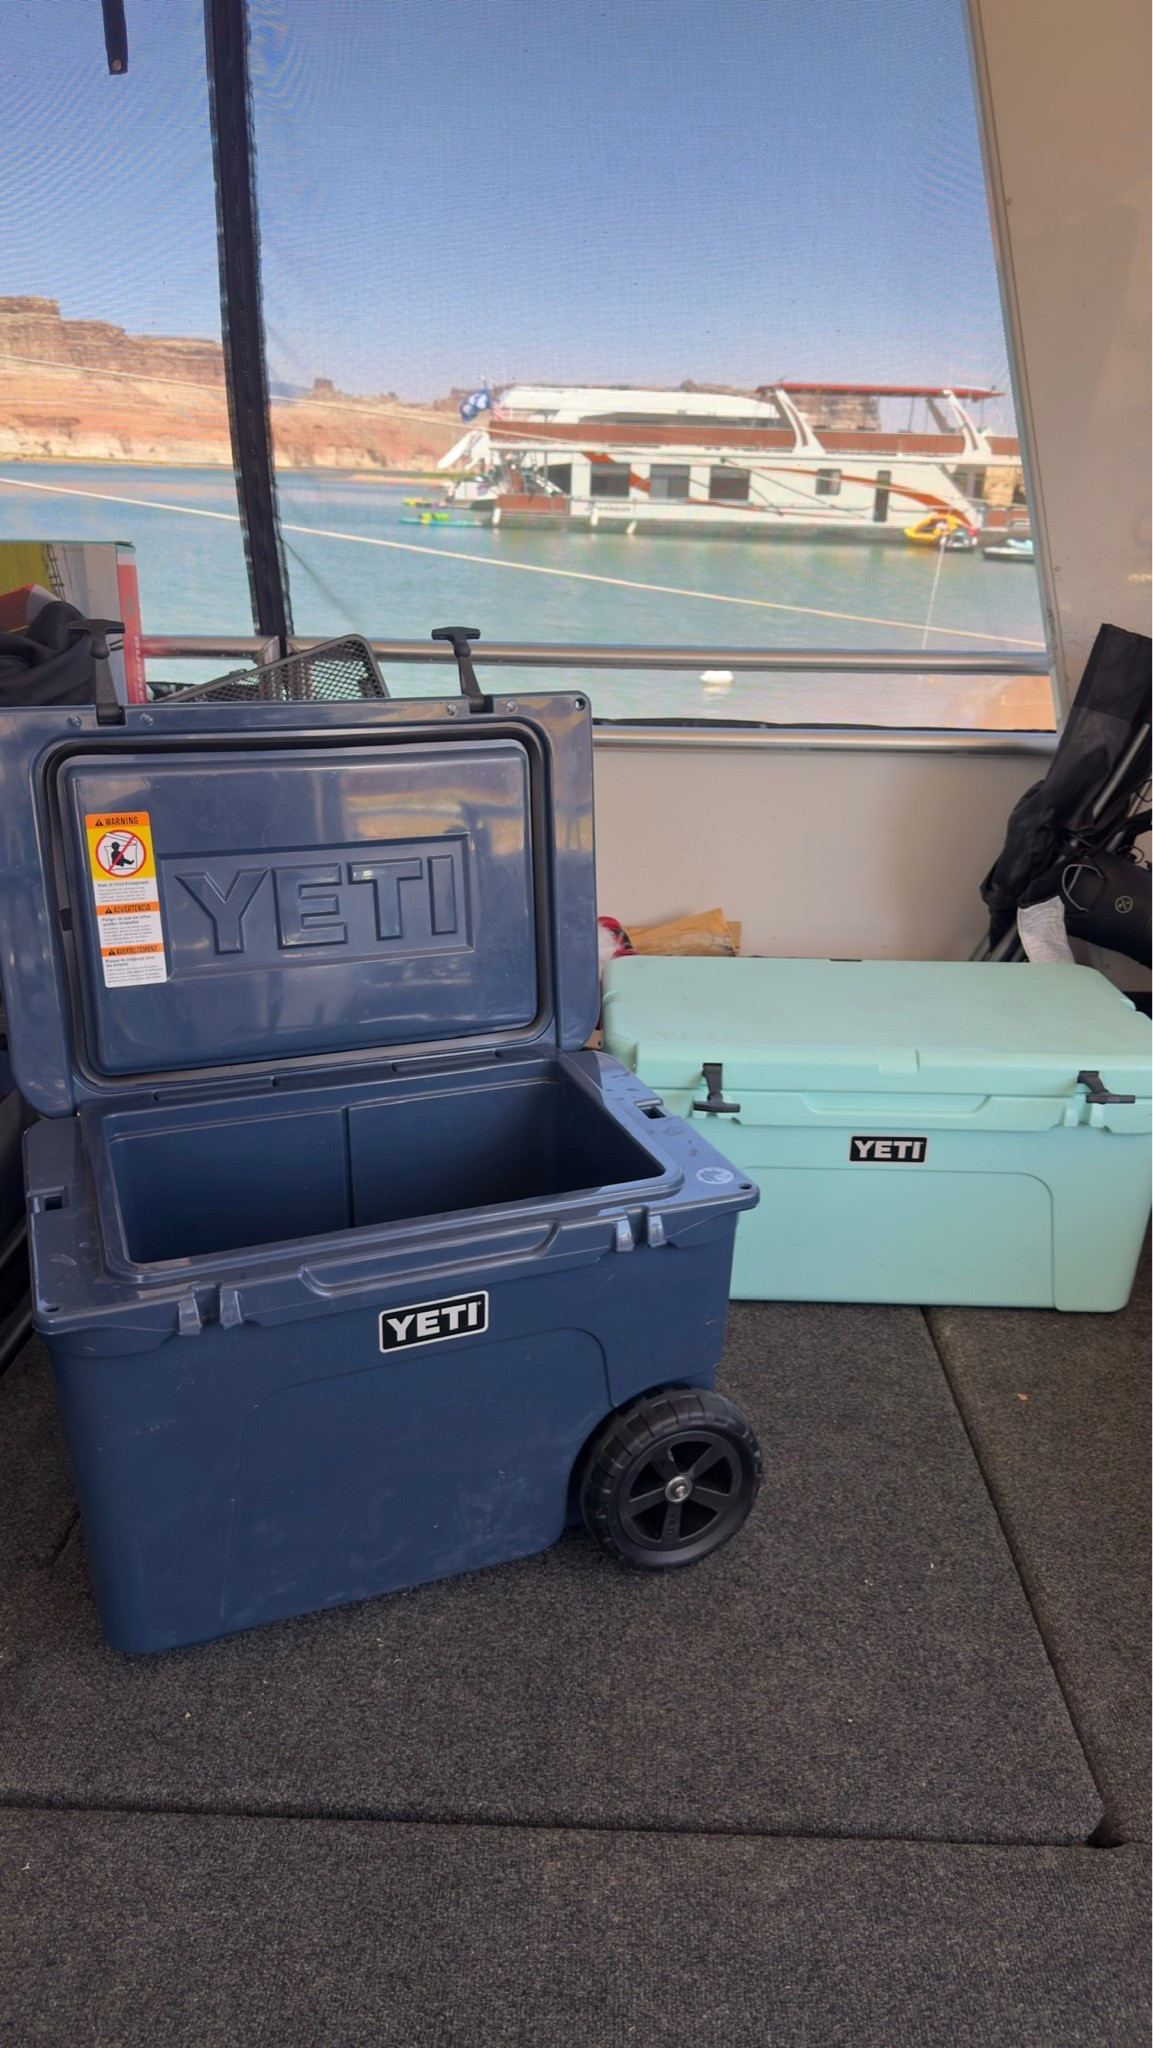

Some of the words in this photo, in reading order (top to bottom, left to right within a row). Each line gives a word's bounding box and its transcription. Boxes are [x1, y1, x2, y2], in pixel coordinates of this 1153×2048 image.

[104, 816, 139, 826] WARNING
[114, 904, 151, 913] ADVERTENCIA
[174, 854, 458, 955] YETI
[854, 1140, 922, 1159] YETI
[386, 1302, 480, 1342] YETI
